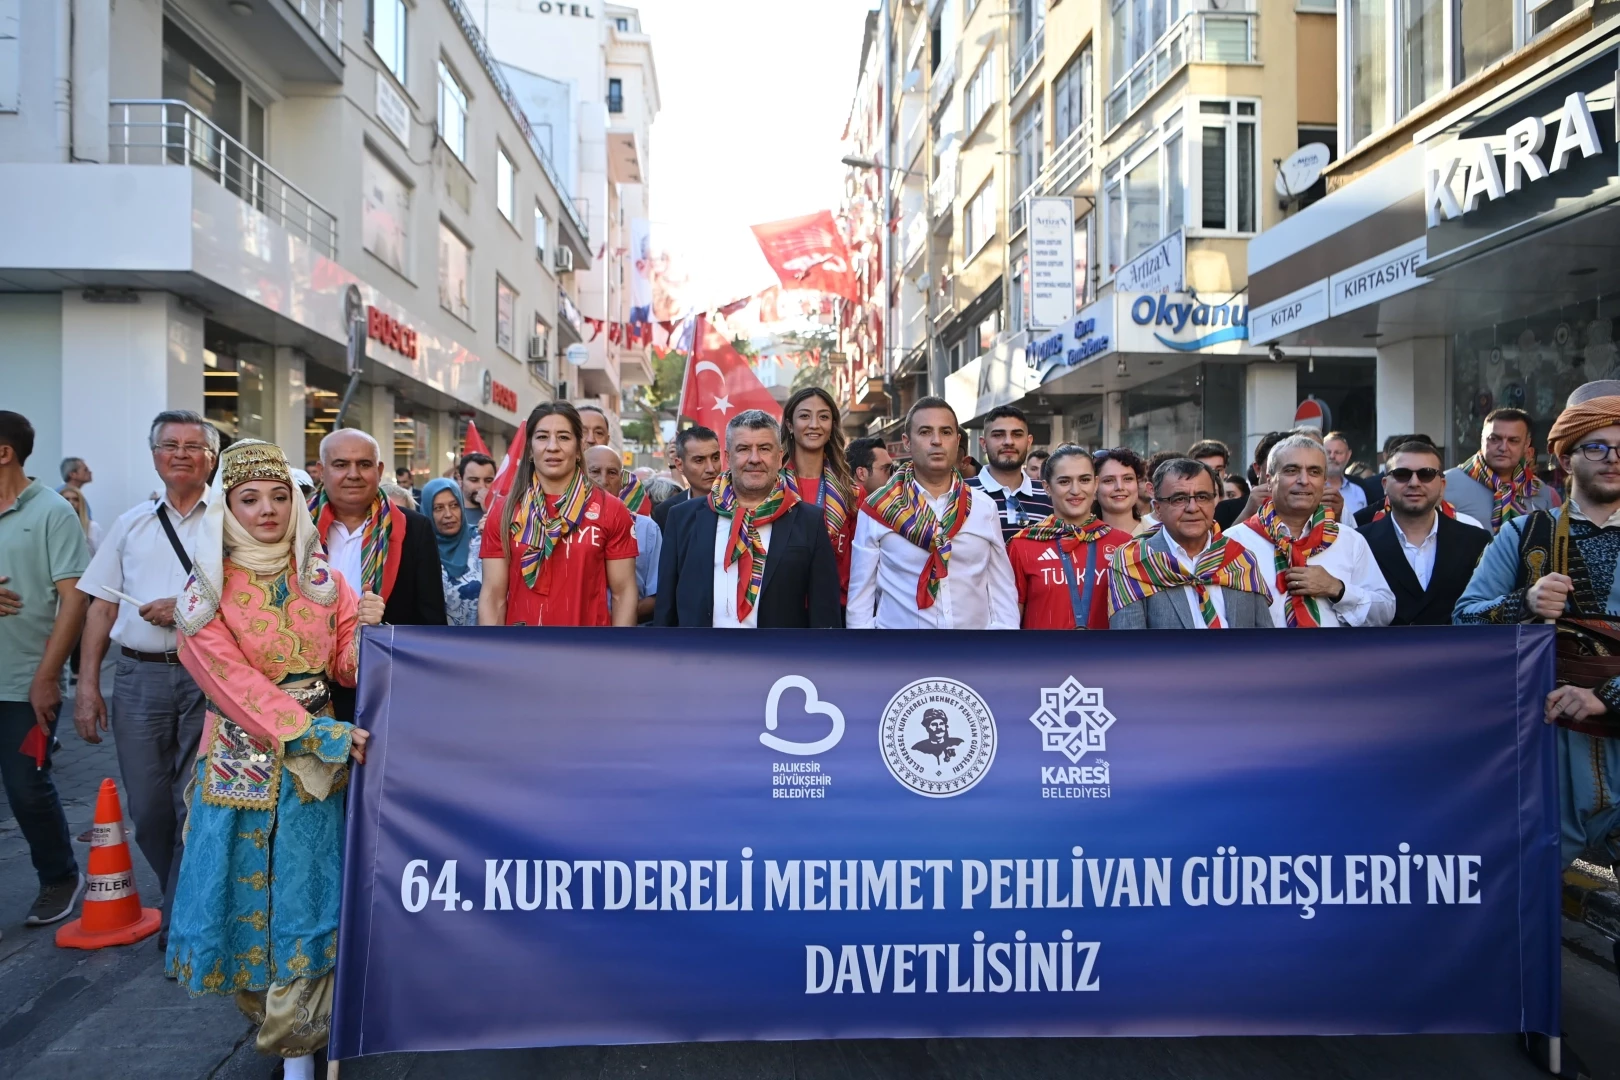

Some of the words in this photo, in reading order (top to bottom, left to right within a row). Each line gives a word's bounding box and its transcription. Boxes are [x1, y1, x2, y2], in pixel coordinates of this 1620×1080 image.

[539, 1, 596, 19] OTEL
[1428, 91, 1602, 229] KARA
[368, 305, 418, 360] BOSCH
[898, 696, 928, 732] KURTDERELİ
[929, 695, 959, 707] MEHMET
[958, 704, 978, 738] PEHLİVAN
[773, 761, 820, 772] BALIKESİR
[897, 734, 925, 774] GELENEKSEL
[773, 773, 832, 787] BÜYÜKŞEHİR
[773, 786, 825, 798] BELEDİYESİ
[1042, 785, 1111, 798] BELEDİYESİ
[401, 859, 474, 913] 64.
[483, 846, 754, 912] KURTDERELİ
[763, 859, 953, 911] MEHMET
[960, 845, 1172, 910] PEHLİVAN
[1181, 842, 1482, 920] GÜREŞLERİ'NE
[804, 929, 1101, 995] DAVETLİSİNİZ
